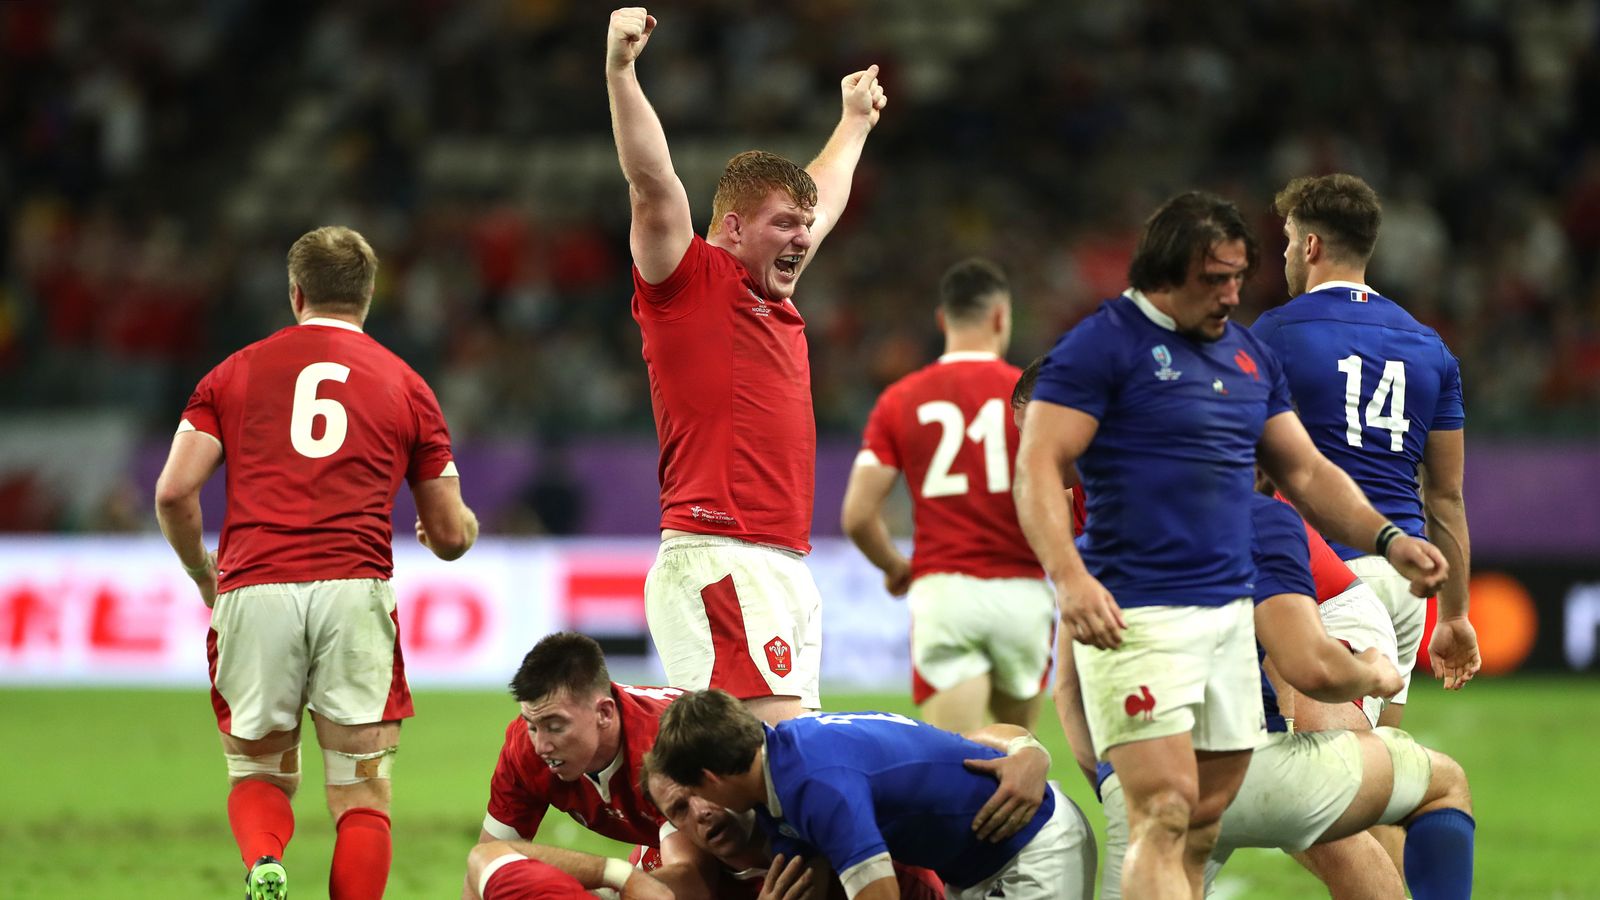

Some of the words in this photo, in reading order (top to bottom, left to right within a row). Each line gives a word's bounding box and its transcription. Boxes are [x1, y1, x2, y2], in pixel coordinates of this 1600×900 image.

[290, 361, 351, 459] 6
[917, 398, 1010, 498] 21
[1338, 355, 1410, 452] 14
